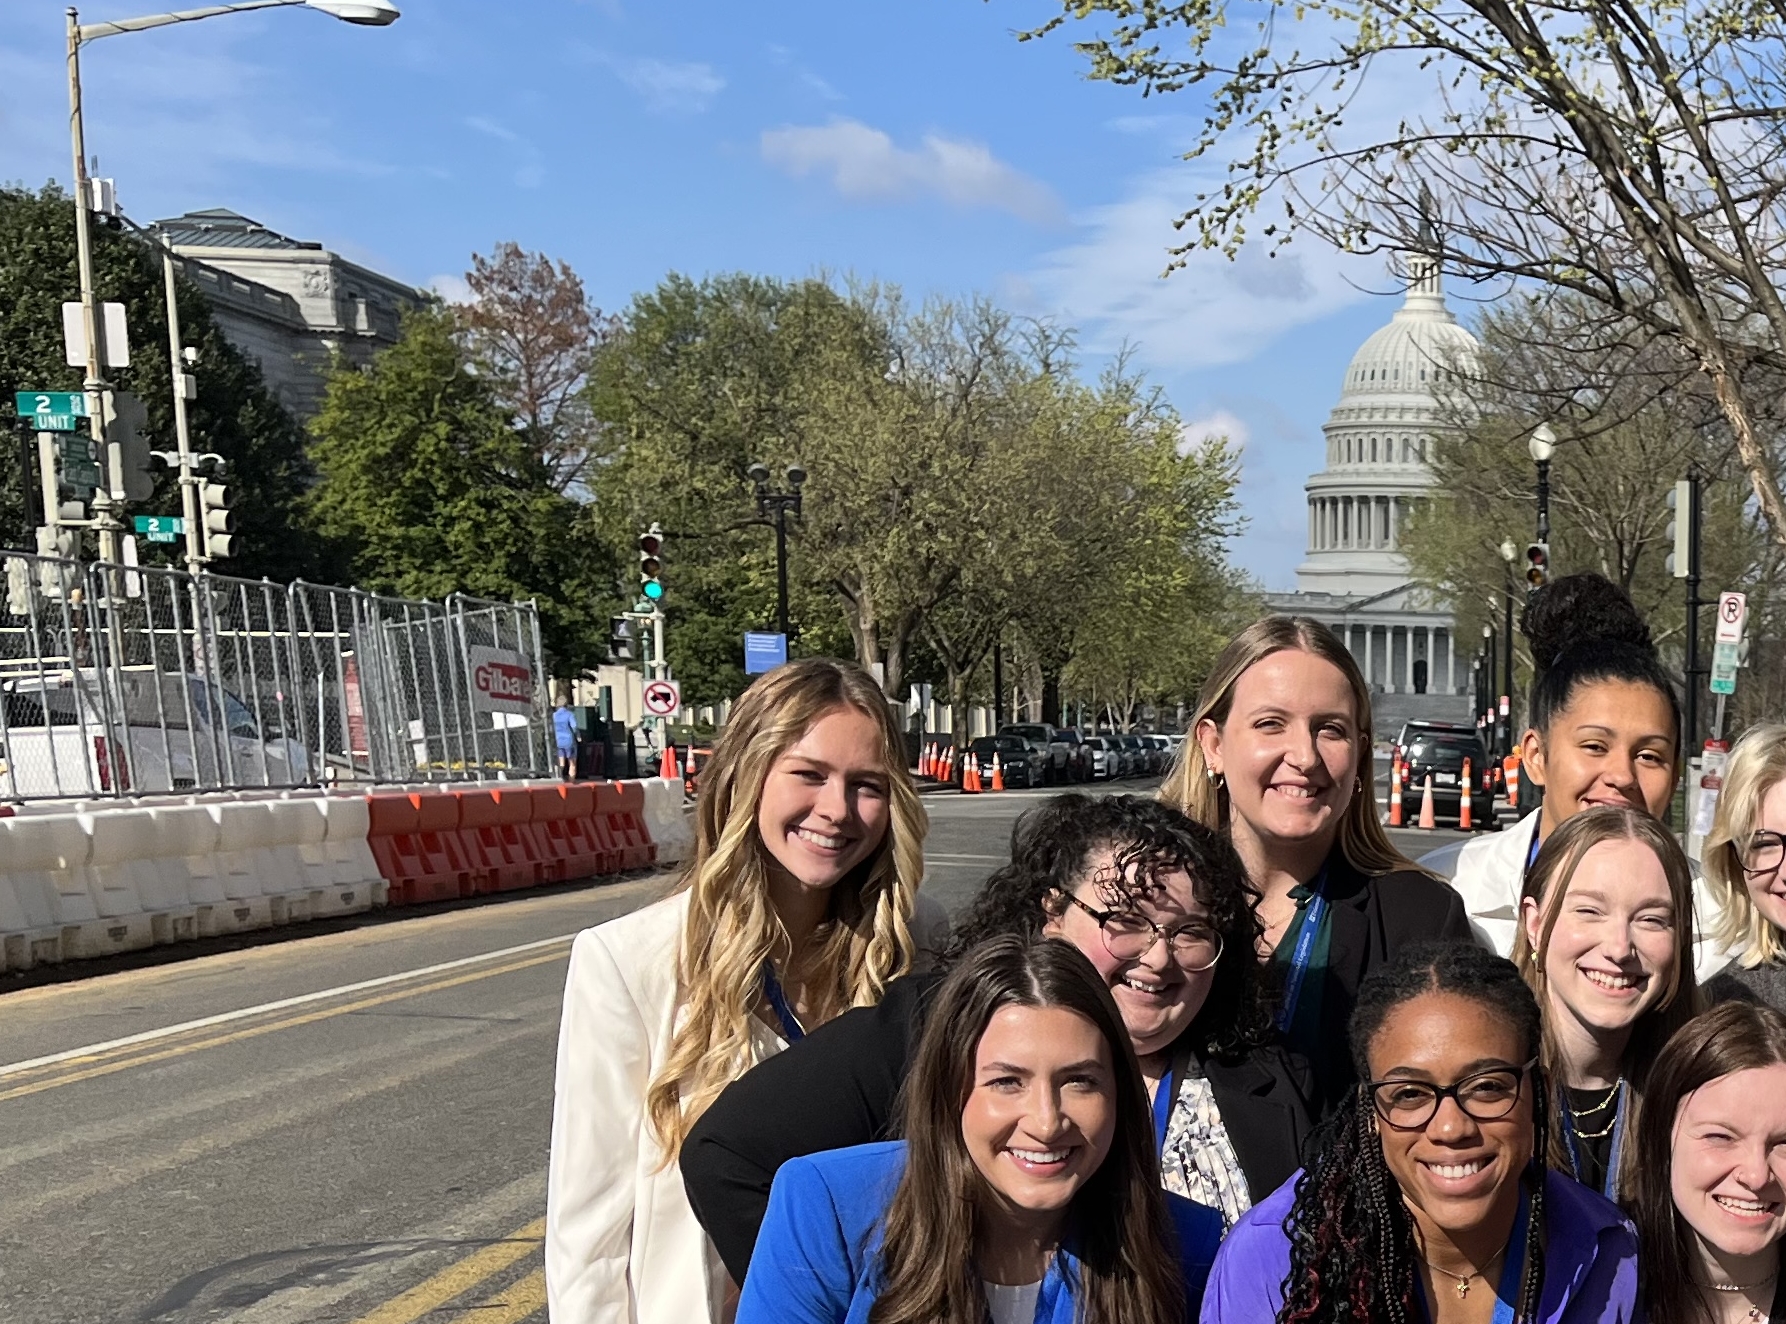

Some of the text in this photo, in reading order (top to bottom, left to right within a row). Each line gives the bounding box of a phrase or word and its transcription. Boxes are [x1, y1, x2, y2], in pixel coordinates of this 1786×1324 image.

[34, 395, 51, 413] 2
[37, 415, 69, 429] UNIT
[147, 518, 159, 532] 2
[148, 532, 175, 542] UNIT
